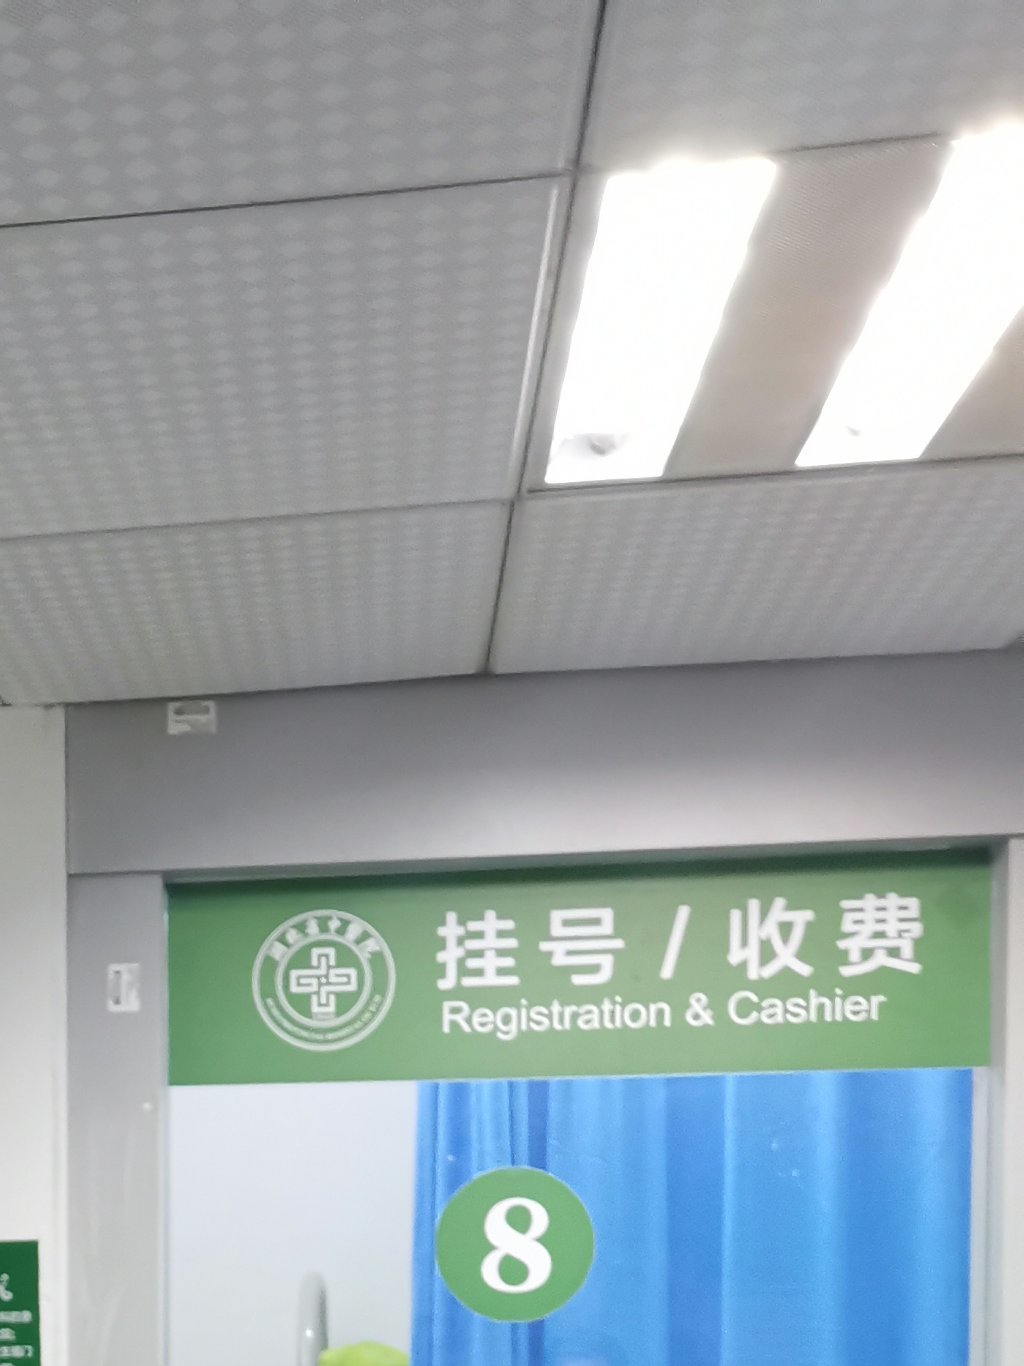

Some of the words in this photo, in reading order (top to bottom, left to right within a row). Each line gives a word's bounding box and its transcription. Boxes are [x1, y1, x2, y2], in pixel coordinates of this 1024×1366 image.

[441, 996, 672, 1038] Registration
[686, 993, 714, 1026] &
[729, 989, 887, 1025] Cashier
[481, 1195, 553, 1294] 8
